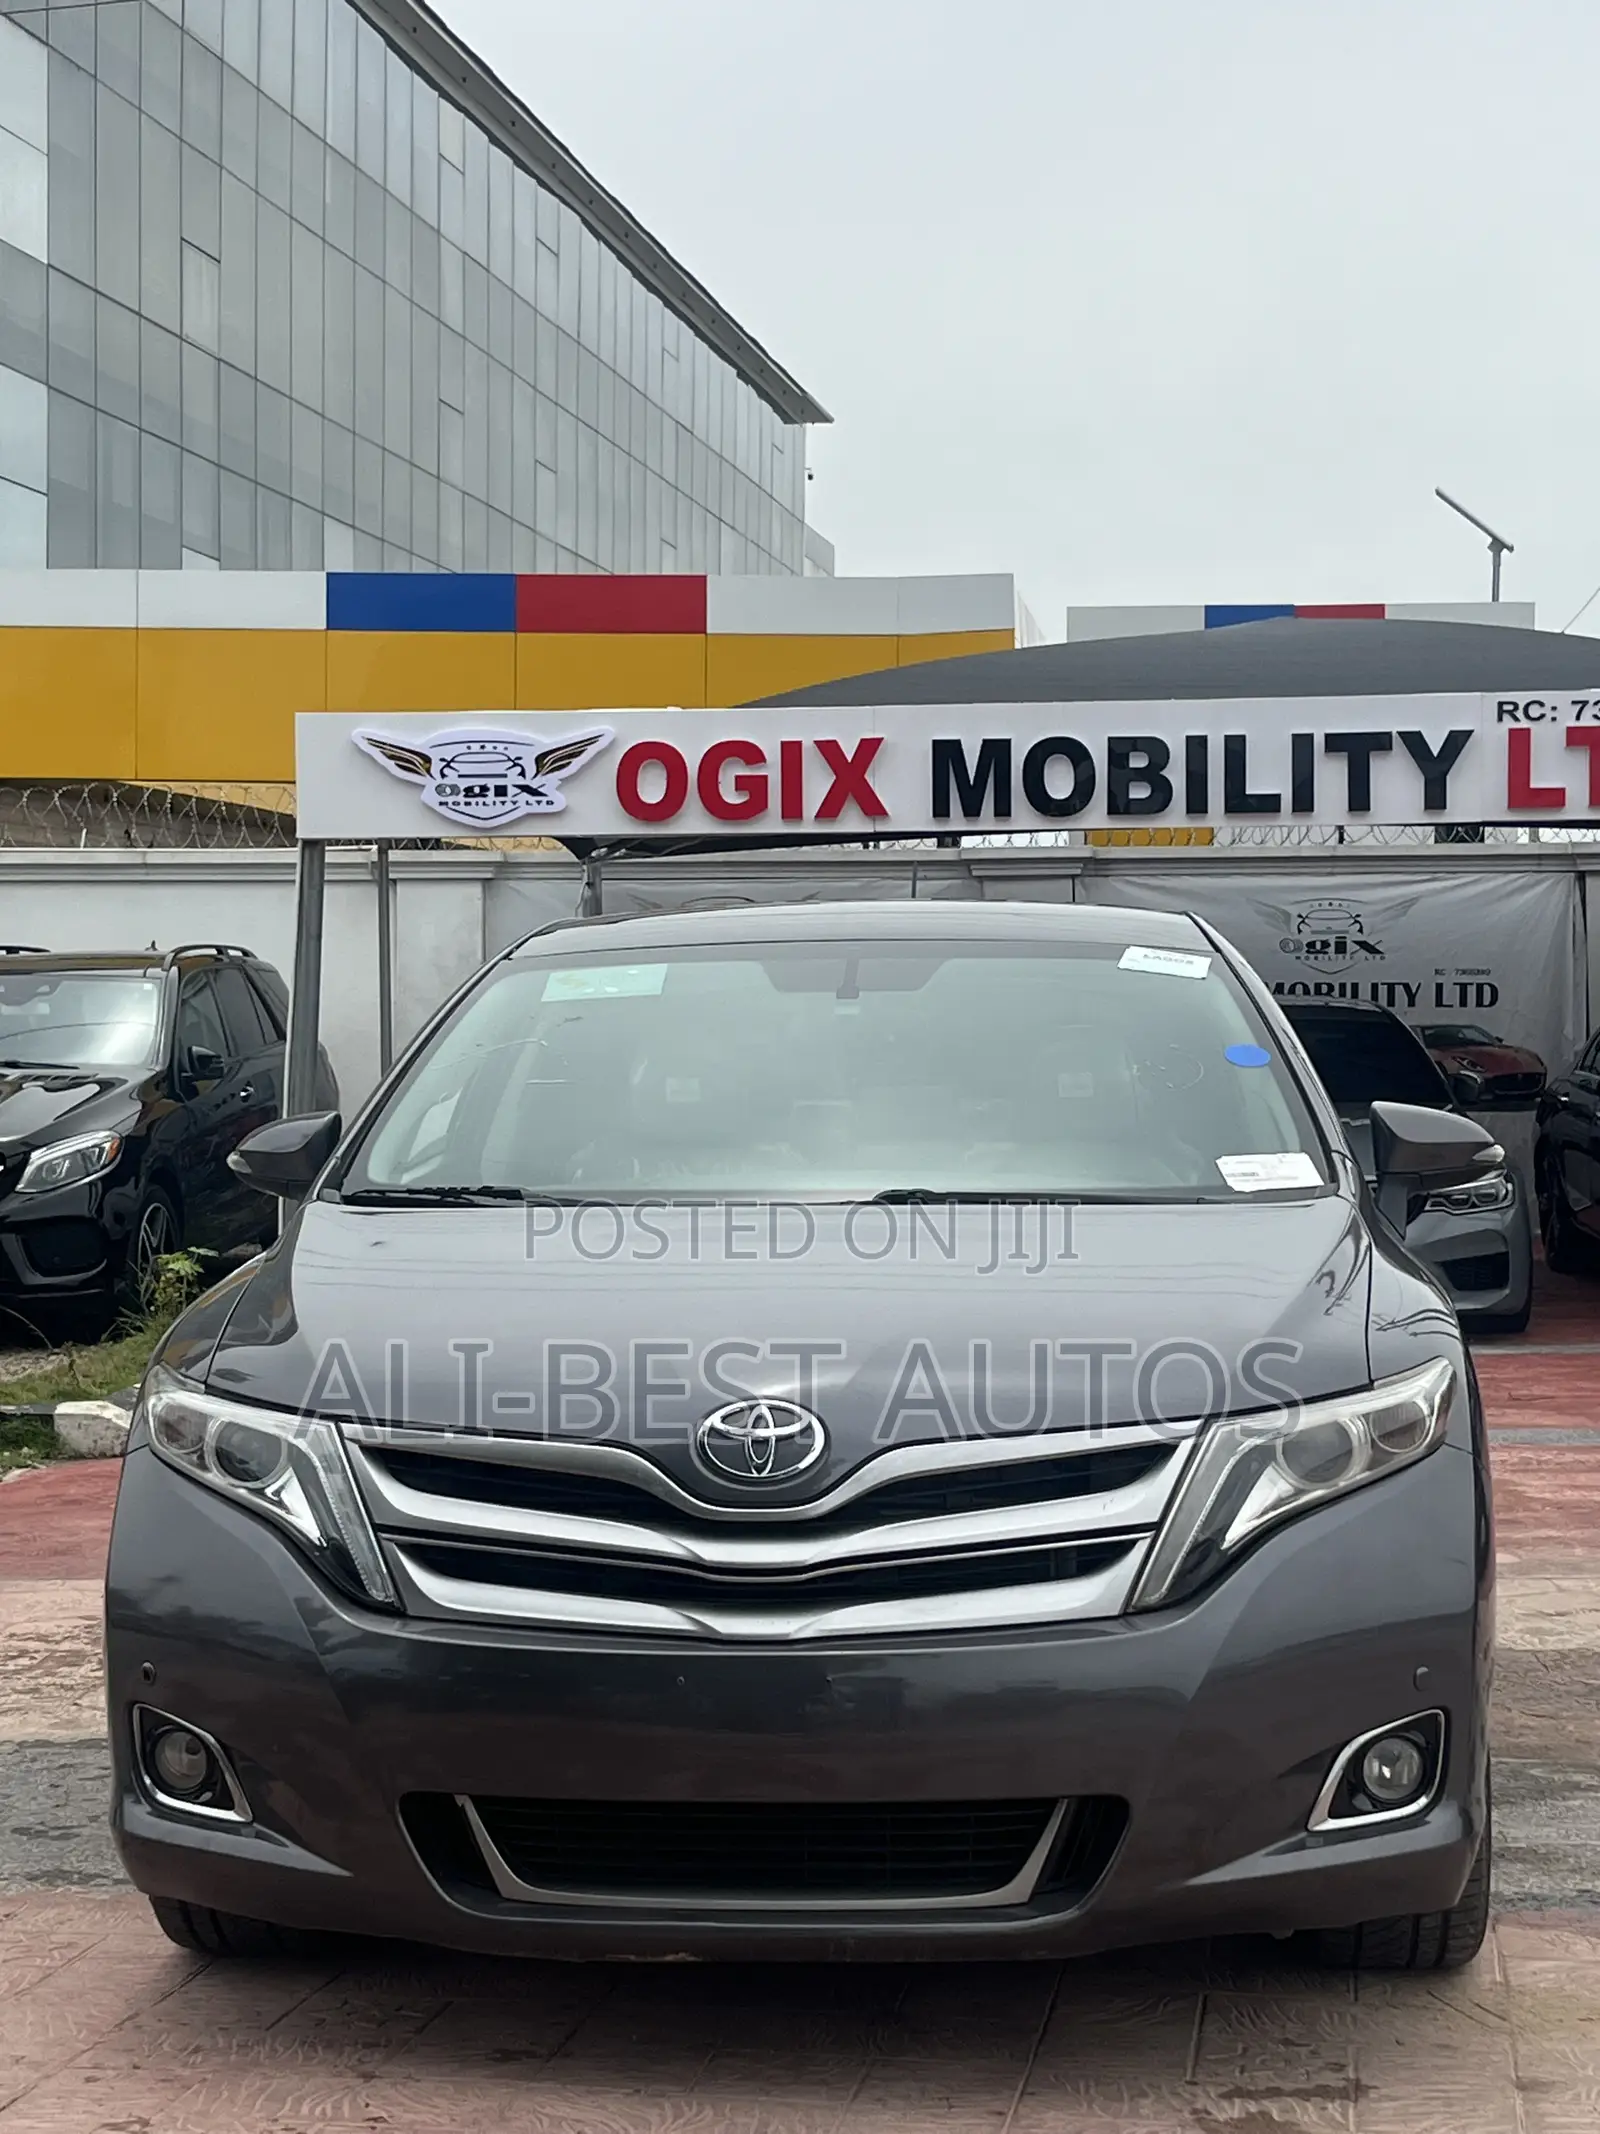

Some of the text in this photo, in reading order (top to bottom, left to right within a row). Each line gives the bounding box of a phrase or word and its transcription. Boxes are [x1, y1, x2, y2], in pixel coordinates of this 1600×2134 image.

[1496, 700, 1558, 723] RC:
[616, 737, 889, 822] OGIX
[931, 729, 1475, 819] MOBILITY
[1434, 982, 1499, 1008] LTD
